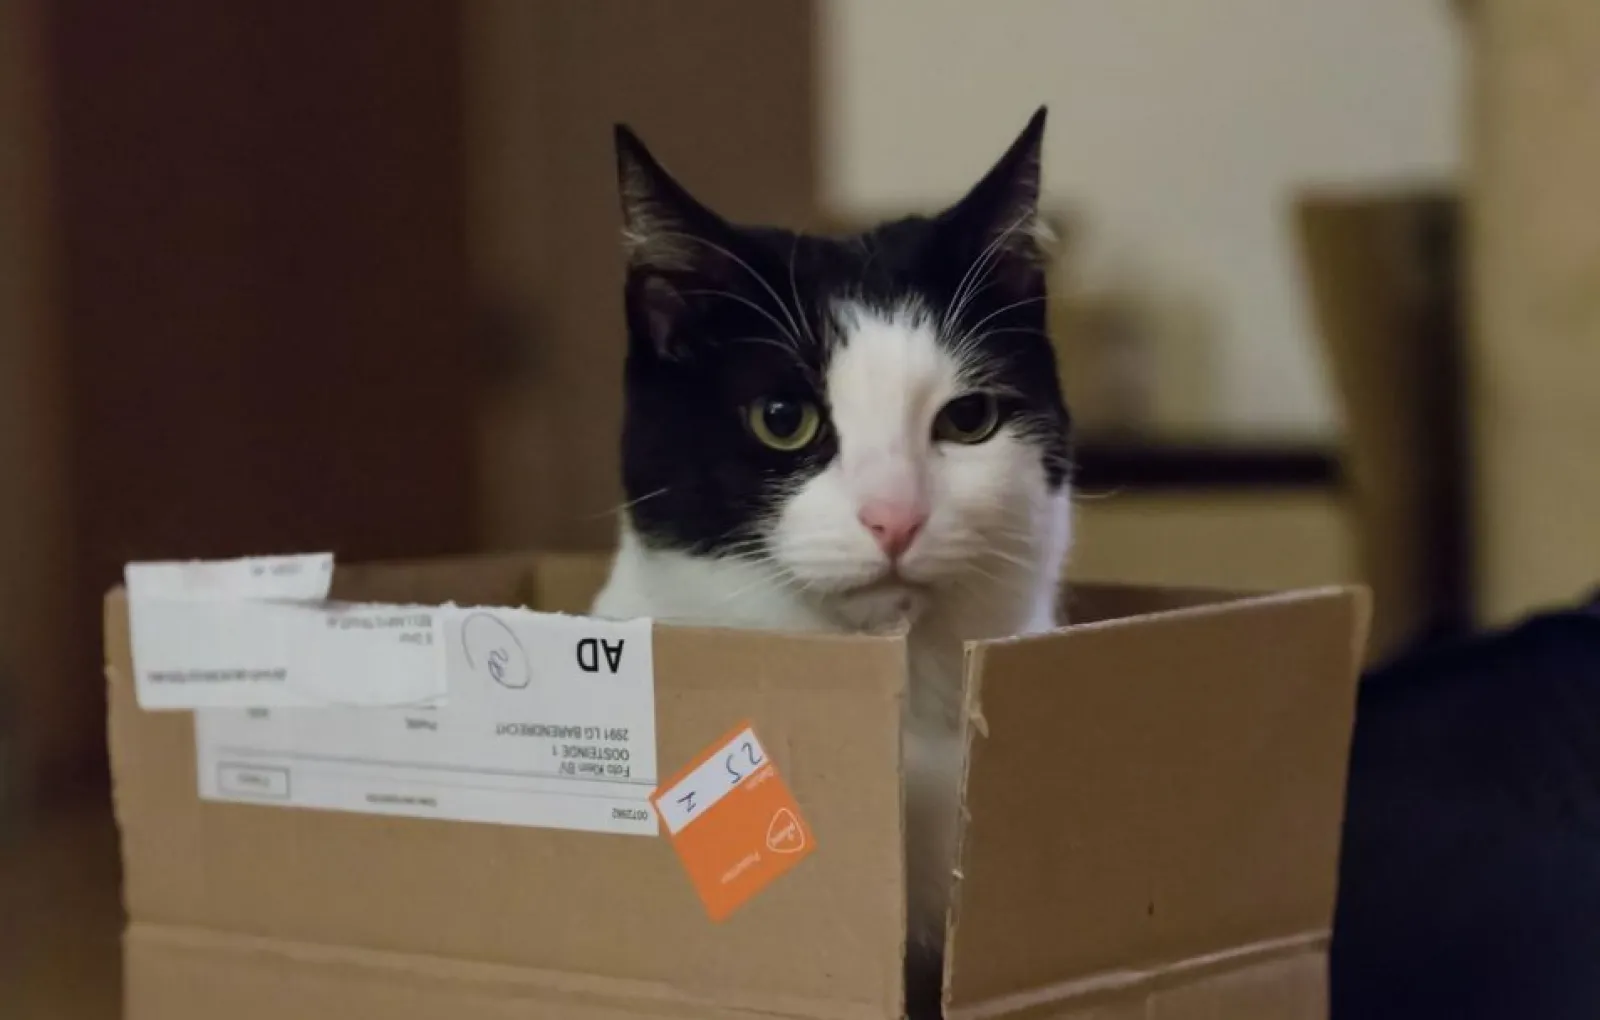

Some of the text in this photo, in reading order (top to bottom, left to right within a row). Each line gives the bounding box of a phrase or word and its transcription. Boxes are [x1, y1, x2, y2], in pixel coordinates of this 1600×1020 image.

[576, 638, 625, 673] AD
[495, 723, 629, 740] 2991 LG BARENDRECHT
